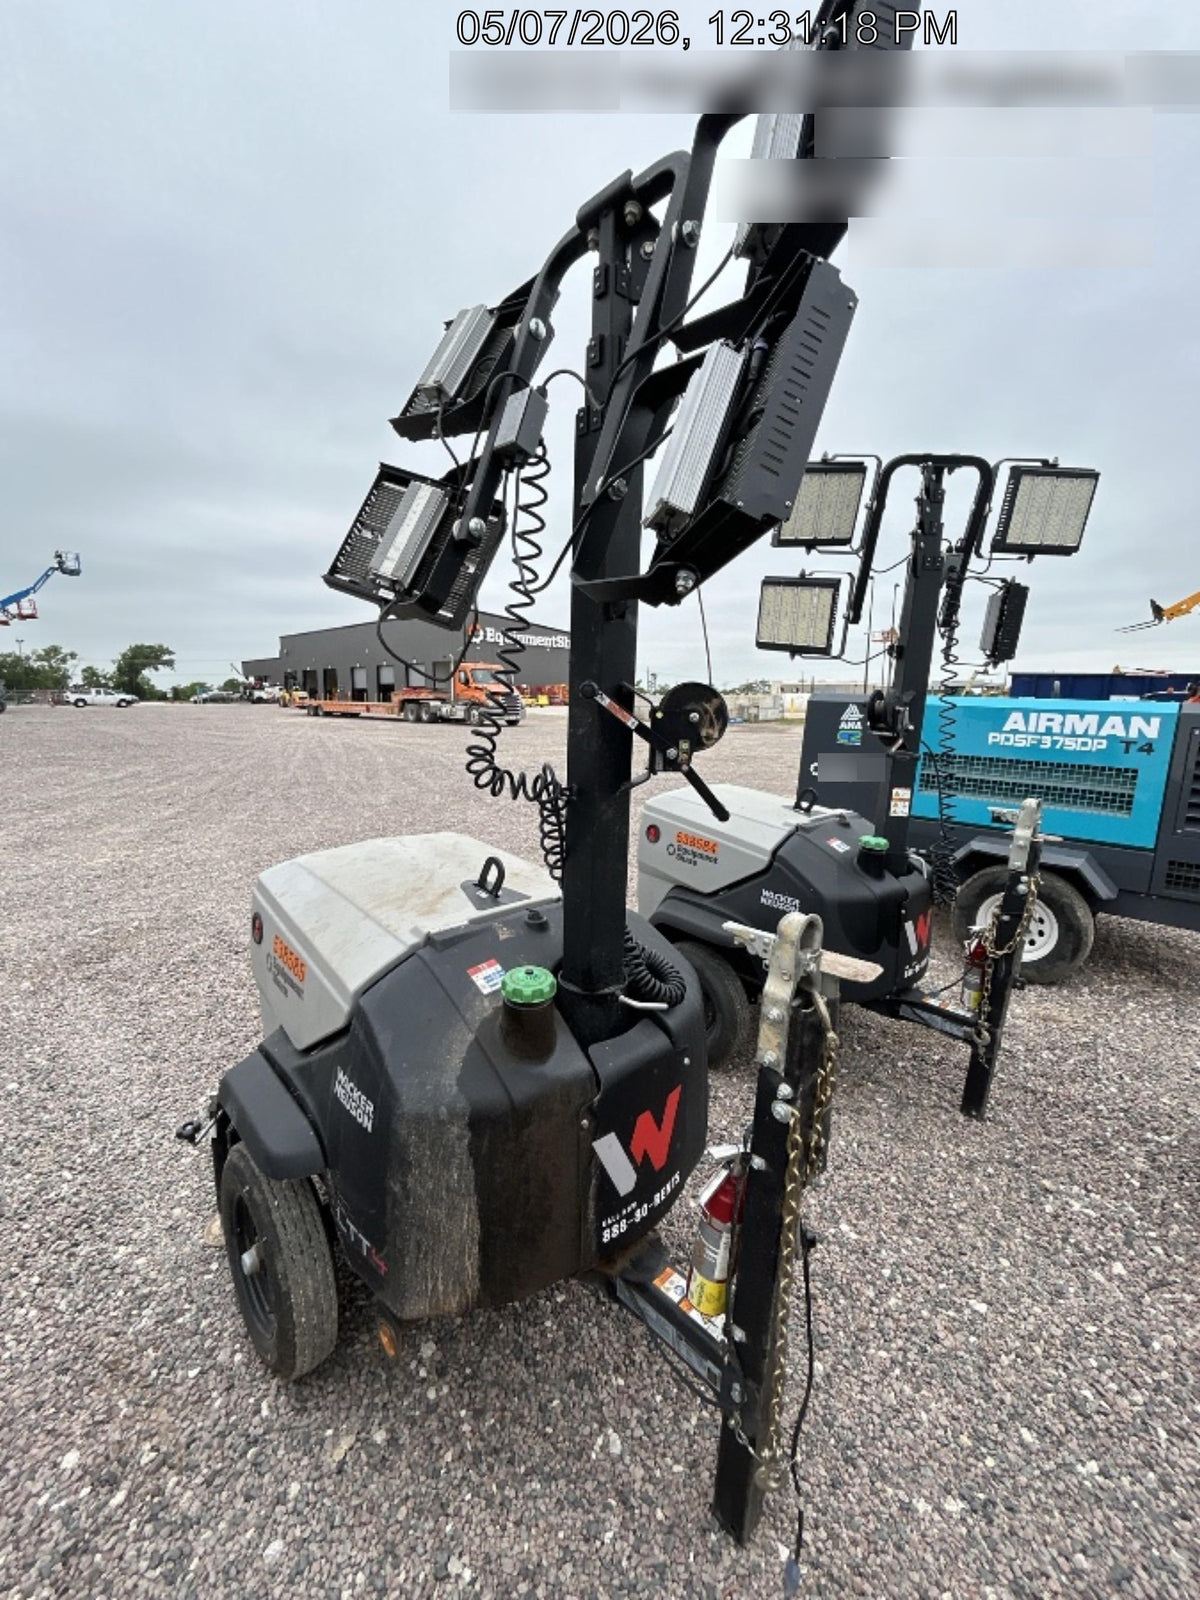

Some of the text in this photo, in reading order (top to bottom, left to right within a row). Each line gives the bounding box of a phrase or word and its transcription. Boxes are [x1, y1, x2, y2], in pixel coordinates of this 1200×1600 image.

[1002, 711, 1162, 740] AIRMAN
[1120, 739, 1155, 756] T4
[333, 1080, 373, 1134] NEUSON
[336, 1065, 375, 1119] WACKER
